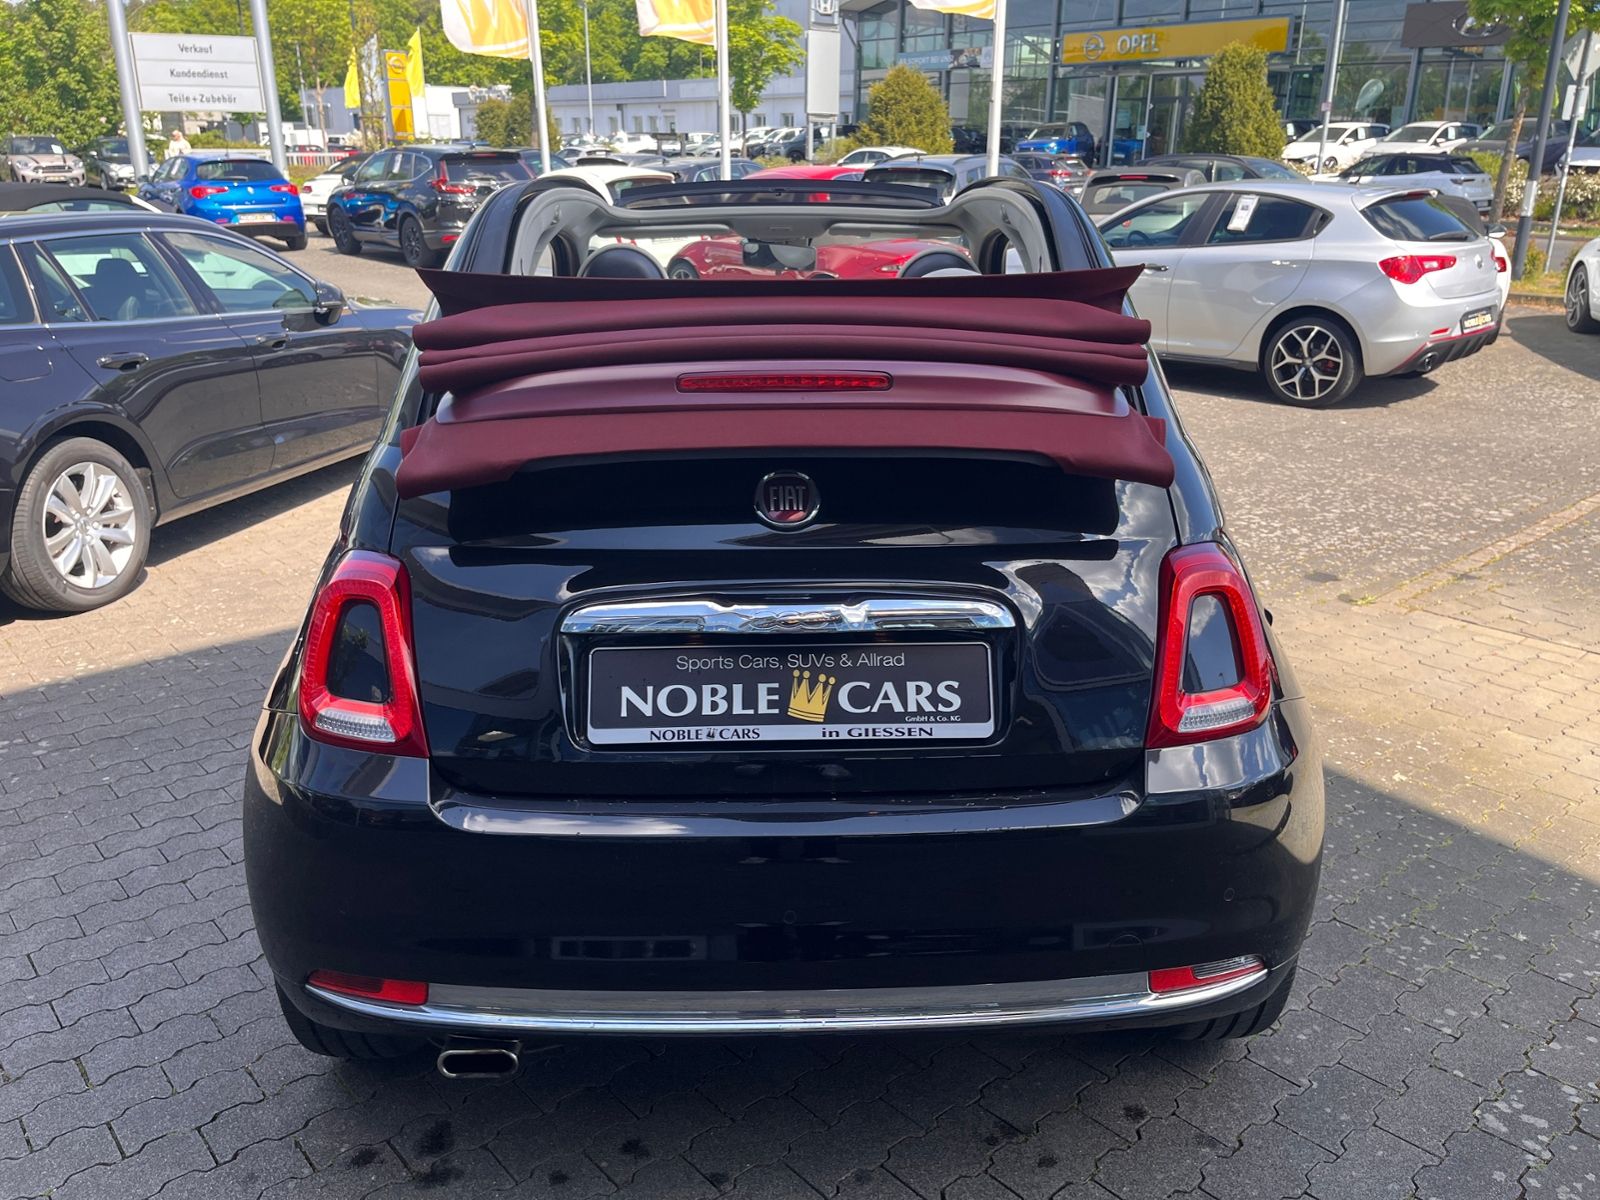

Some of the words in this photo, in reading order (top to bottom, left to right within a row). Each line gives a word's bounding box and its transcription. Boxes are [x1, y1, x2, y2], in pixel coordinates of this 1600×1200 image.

[178, 43, 213, 54] Verkauf
[1117, 33, 1160, 55] OPEL
[169, 68, 229, 79] Kundendienst
[769, 485, 806, 511] FIAT
[676, 655, 734, 672] Sports
[738, 654, 784, 670] Cars,
[787, 653, 835, 668] SUVs
[839, 654, 853, 667] &
[856, 652, 905, 667] Allrad
[621, 682, 779, 717] NOBLE
[838, 681, 961, 713] CARS
[905, 715, 928, 723] GmbH
[650, 729, 703, 741] NOBLE
[718, 728, 760, 740] CARS
[821, 727, 840, 738] in
[847, 727, 933, 737] GIESSEN
